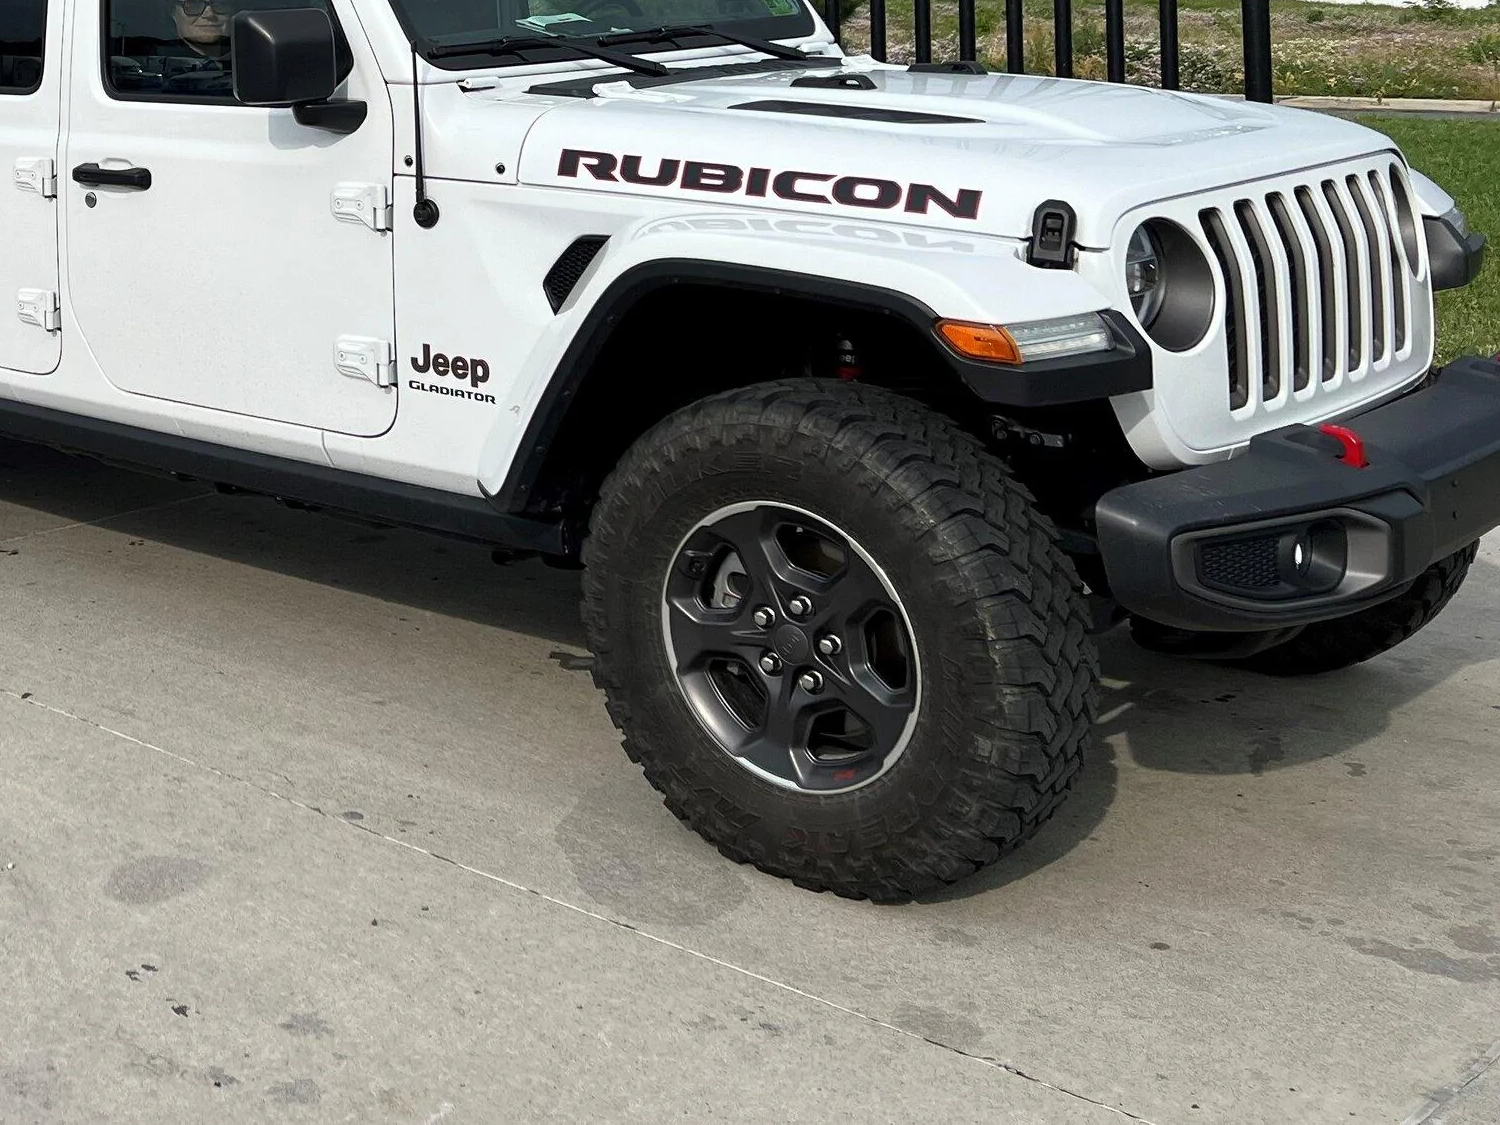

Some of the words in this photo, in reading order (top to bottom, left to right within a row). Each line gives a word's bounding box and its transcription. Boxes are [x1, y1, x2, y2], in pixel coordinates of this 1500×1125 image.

[557, 148, 983, 220] RUBICON
[410, 343, 490, 389] Jeep
[408, 380, 497, 405] GLADIATOR
